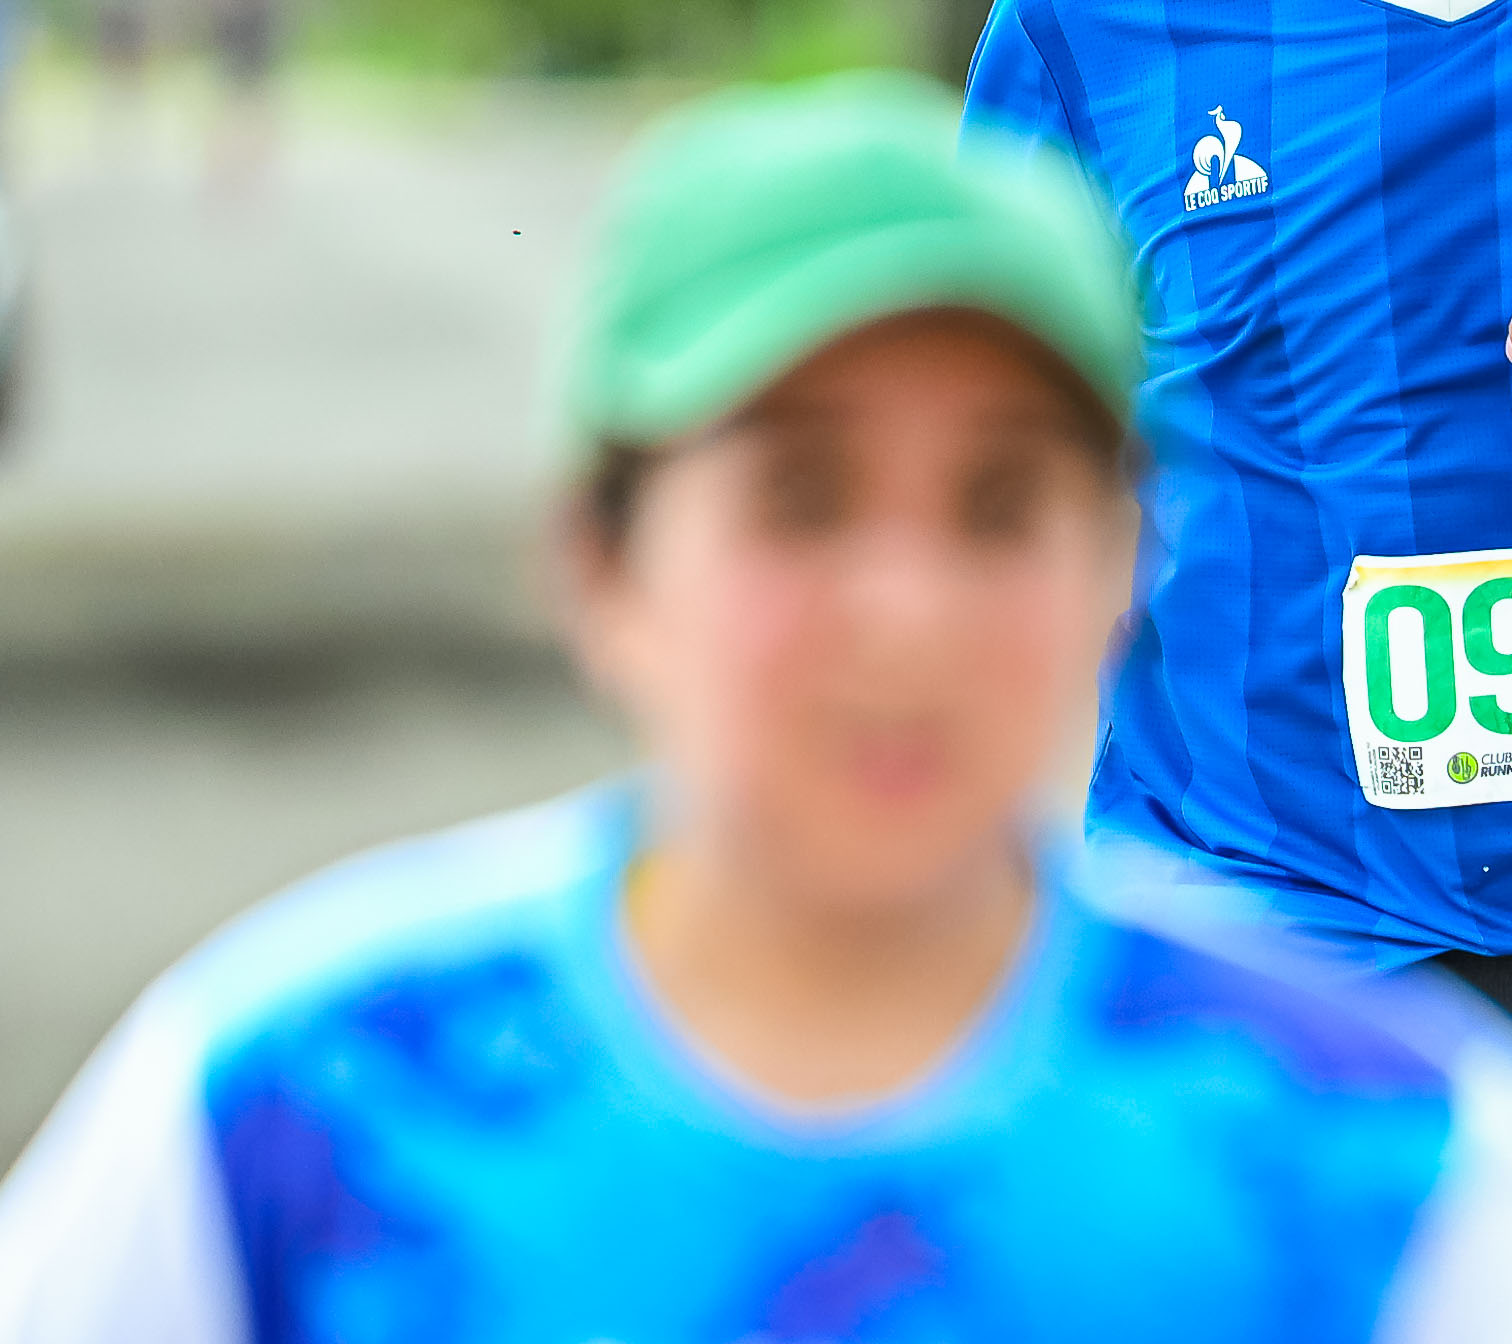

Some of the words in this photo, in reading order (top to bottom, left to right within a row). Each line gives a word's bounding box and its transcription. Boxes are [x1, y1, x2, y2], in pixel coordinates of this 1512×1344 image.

[1185, 194, 1197, 212] LE
[1197, 188, 1220, 208] COQ
[1220, 177, 1268, 201] SPORTIF
[1481, 752, 1512, 766] CLUB
